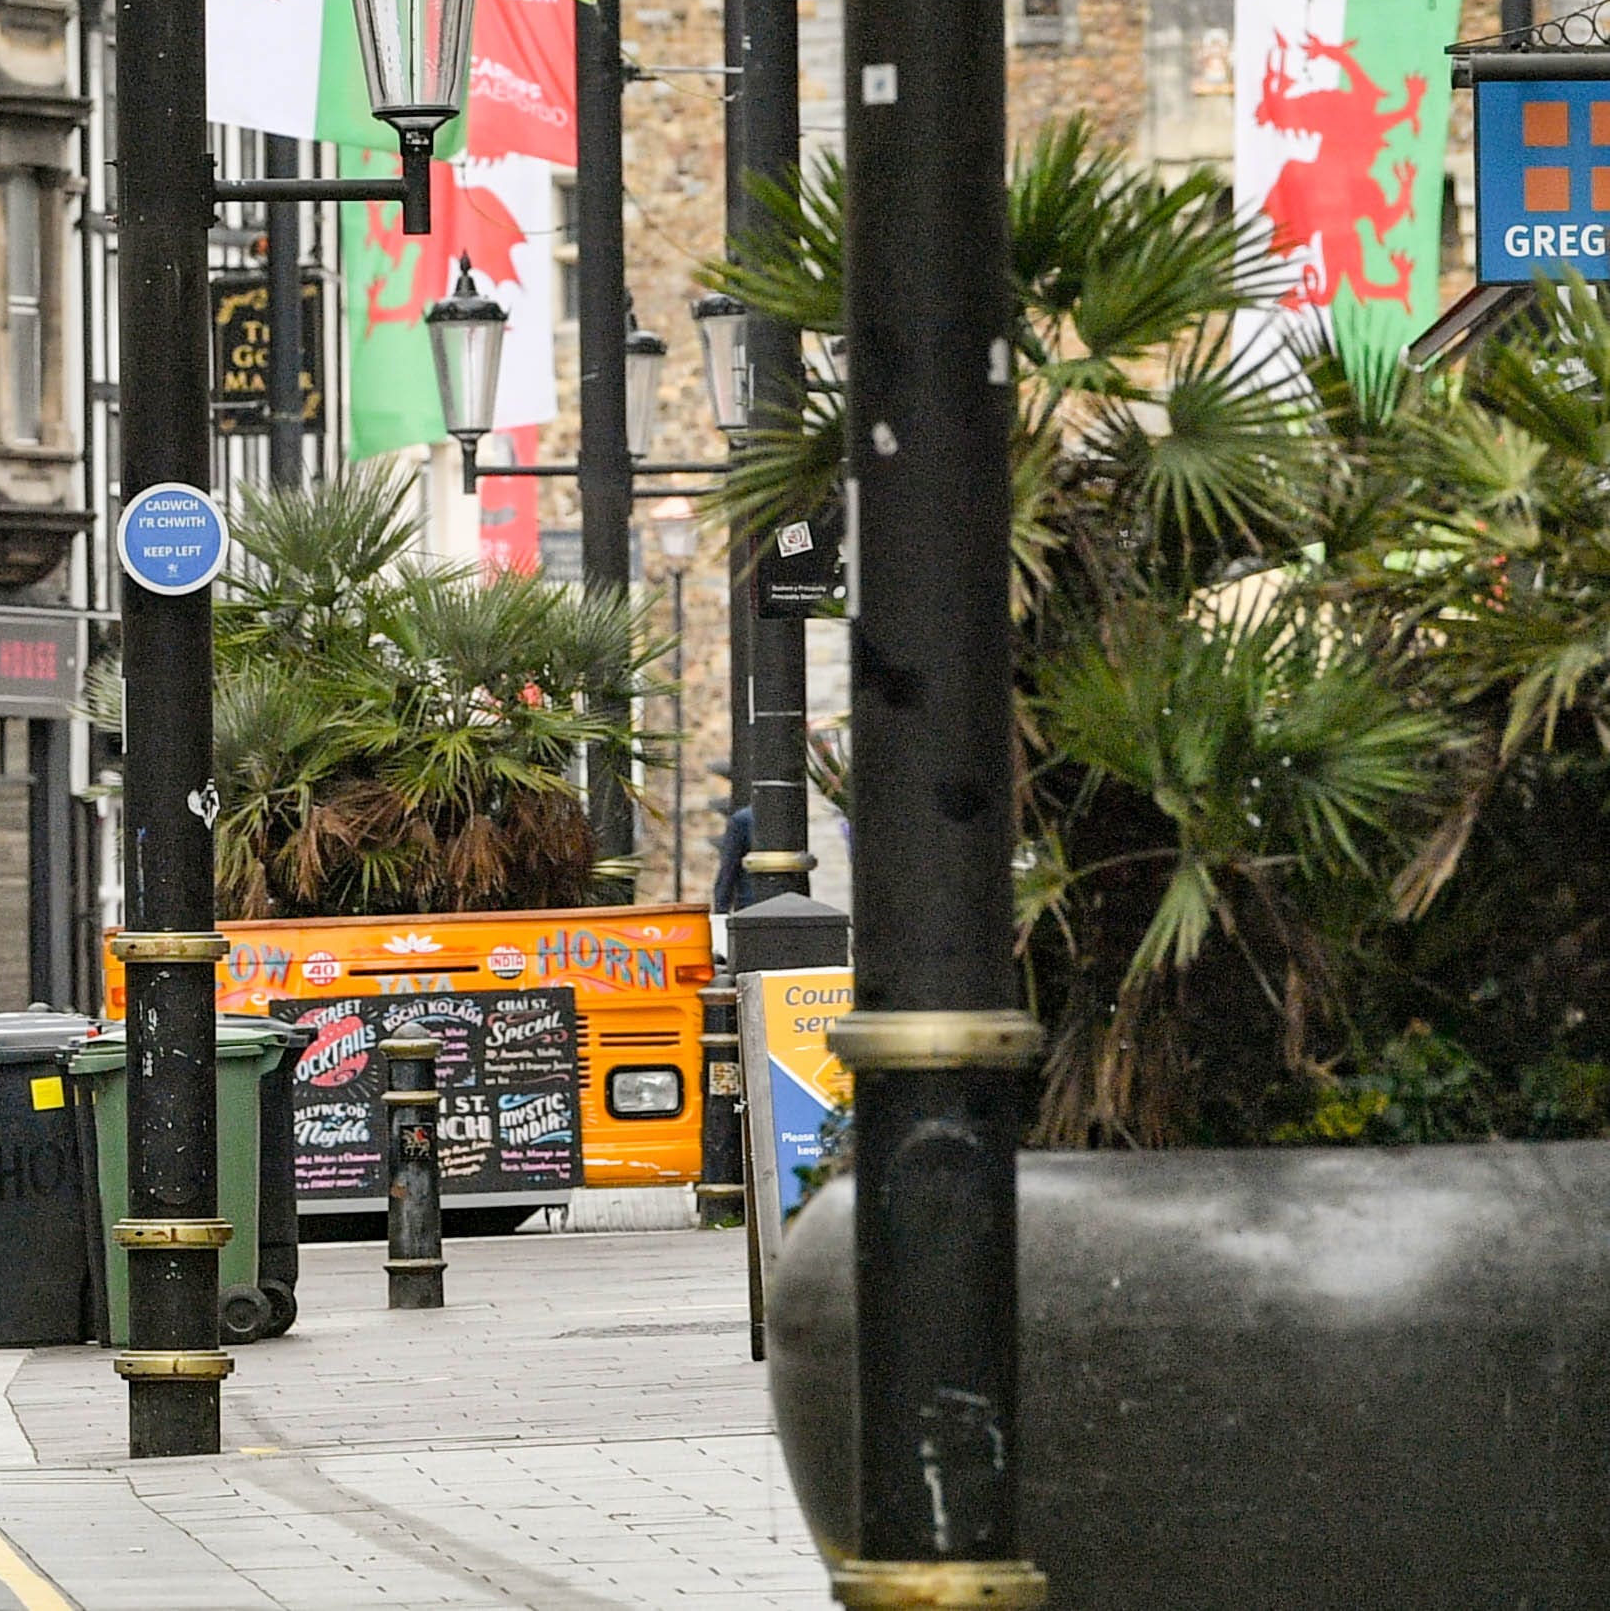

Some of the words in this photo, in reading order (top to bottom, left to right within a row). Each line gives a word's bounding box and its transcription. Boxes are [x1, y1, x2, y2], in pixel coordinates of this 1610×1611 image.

[145, 500, 199, 512] CADWCH
[138, 516, 155, 528] I'R
[157, 516, 206, 528] CHWITH
[144, 546, 173, 558] KEEP
[175, 545, 202, 557] LEFT
[227, 940, 294, 989] OW
[490, 952, 525, 969] INDIA
[537, 929, 669, 990] HORN
[496, 996, 529, 1012] CHAI
[531, 998, 551, 1010] ST.
[785, 986, 854, 1007] Coun
[314, 999, 361, 1030] STREET
[382, 1003, 426, 1032] KOCHI
[427, 1000, 484, 1028] KOLADA
[485, 1010, 564, 1047] SPECIAL
[293, 1024, 377, 1085] OCKTAILS
[454, 1095, 490, 1113] ST.
[499, 1091, 567, 1128] MYSTIC
[437, 1115, 493, 1140] NCH
[781, 1132, 815, 1142] Please
[796, 1144, 823, 1157] keep
